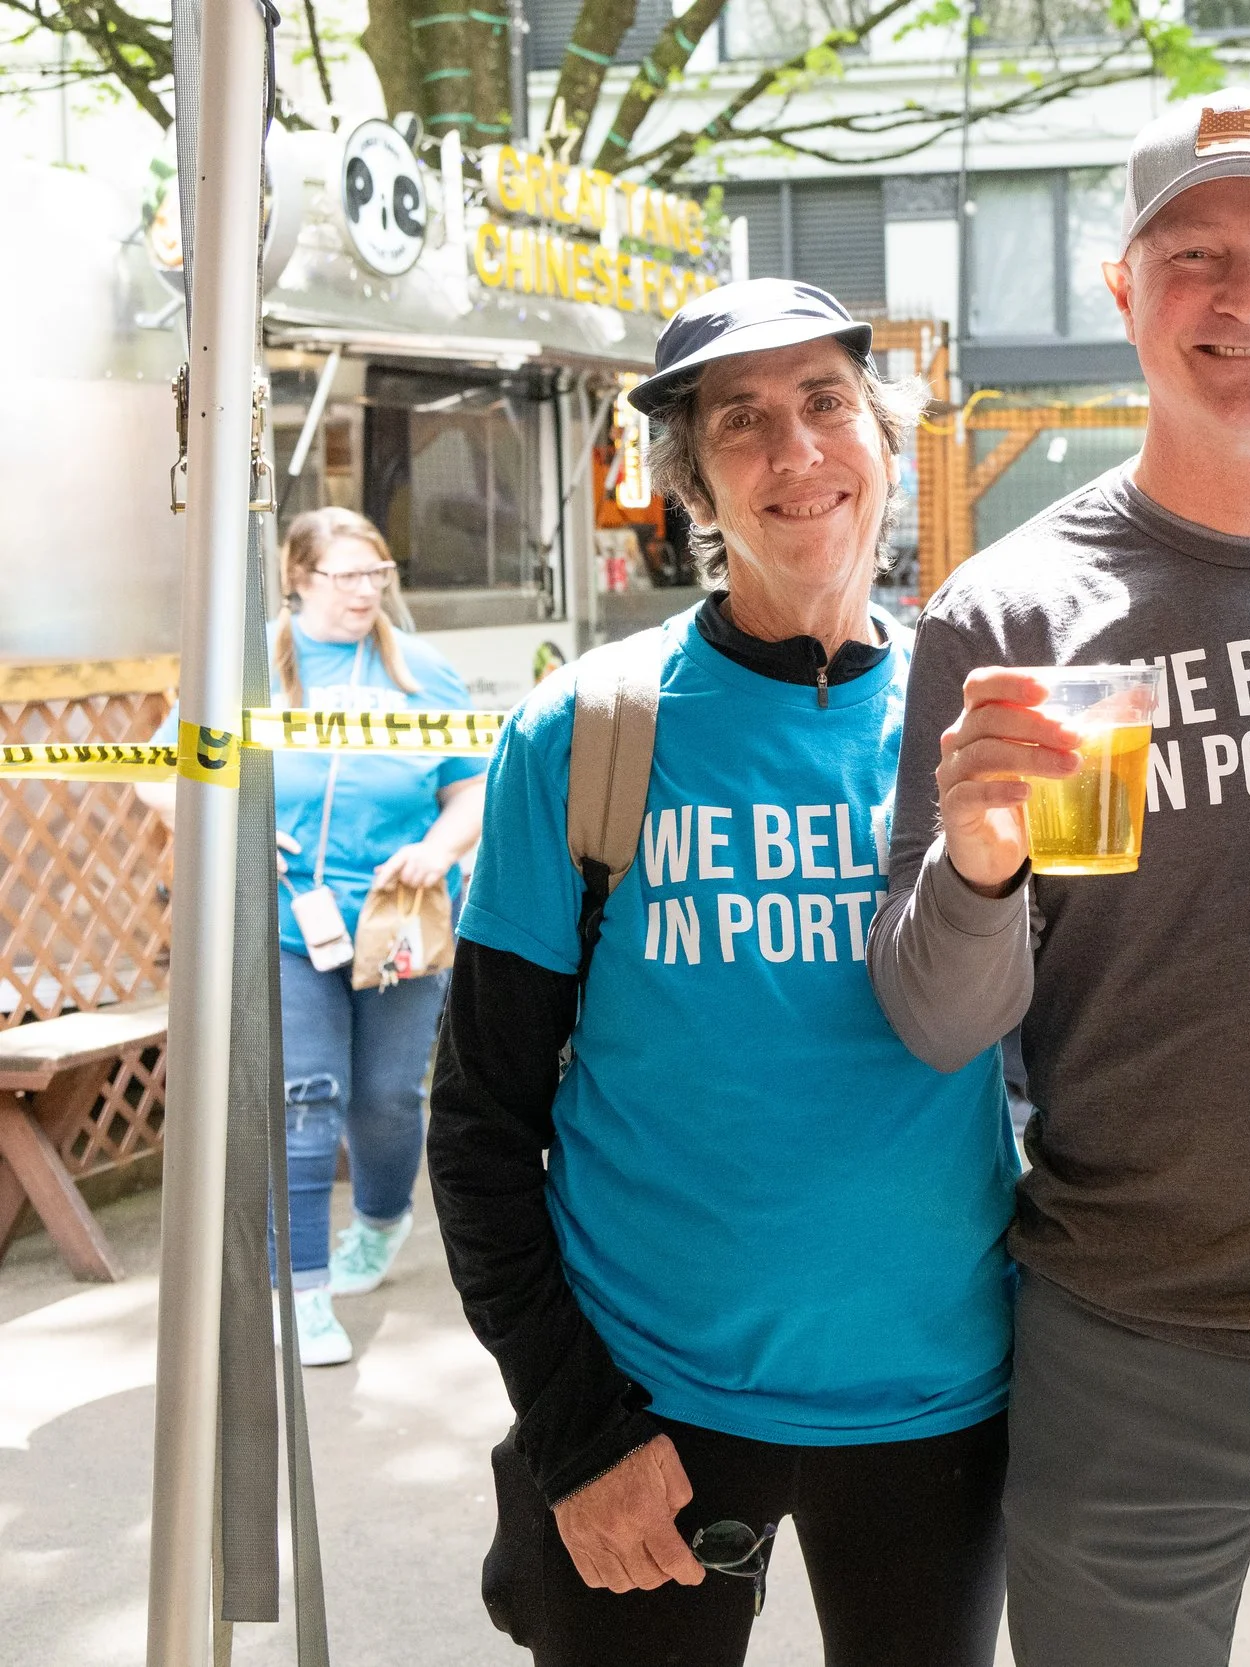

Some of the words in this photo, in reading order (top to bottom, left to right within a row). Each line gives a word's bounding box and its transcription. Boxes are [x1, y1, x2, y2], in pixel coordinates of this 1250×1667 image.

[474, 222, 634, 312] CHINESE
[642, 260, 718, 320] FOO
[643, 804, 734, 888] WE
[644, 896, 700, 965] IN
[717, 891, 888, 963] PORT
